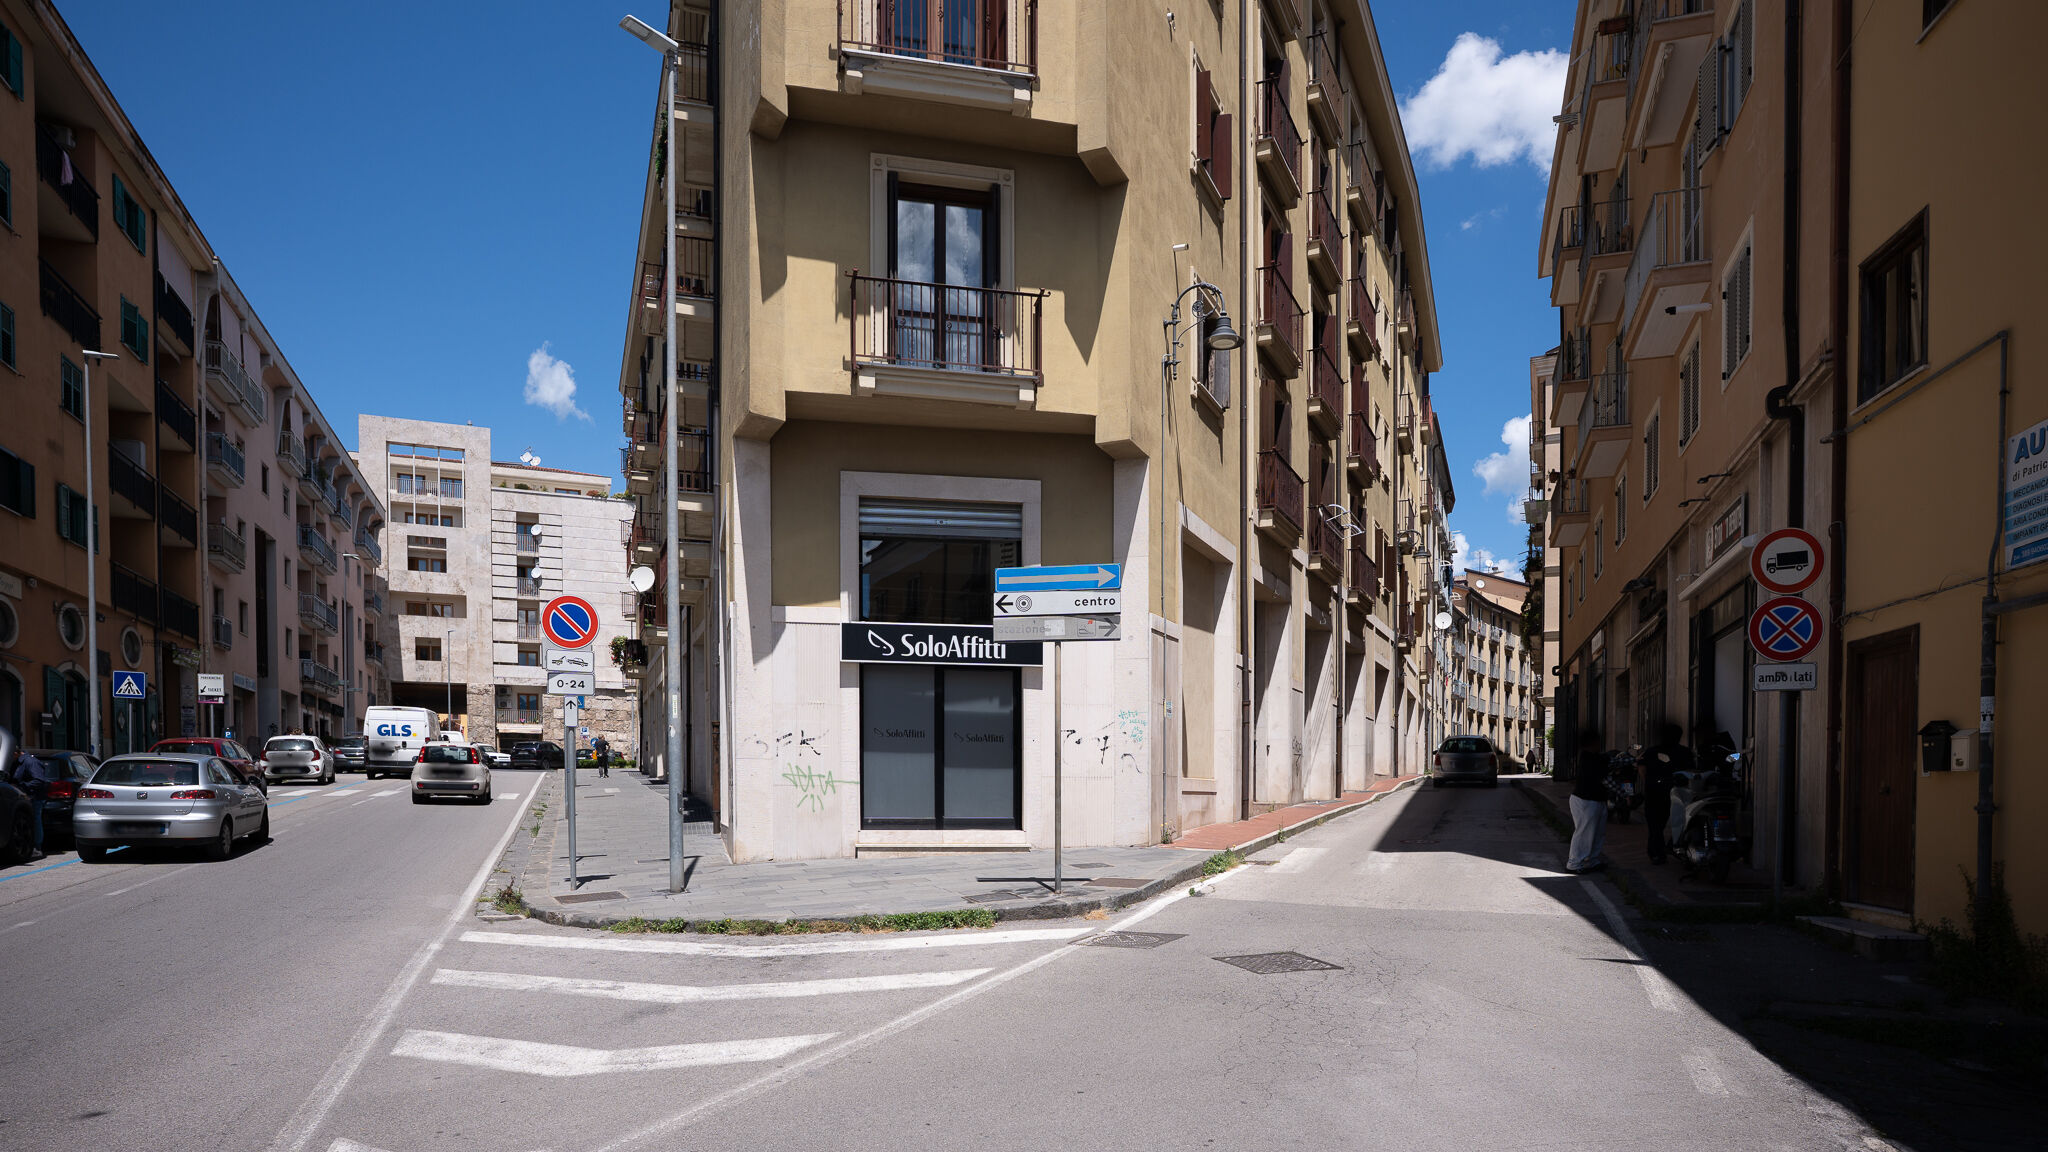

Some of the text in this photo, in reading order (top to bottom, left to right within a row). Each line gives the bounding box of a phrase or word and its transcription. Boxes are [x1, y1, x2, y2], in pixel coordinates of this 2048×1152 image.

[2014, 426, 2048, 465] AU
[1074, 596, 1116, 607] centro
[901, 633, 1006, 659] SoloAffitti
[1758, 671, 1788, 682] ambo
[1794, 671, 1812, 682] lati
[556, 679, 585, 689] 0-24
[886, 728, 925, 739] SoloAffitti
[966, 733, 1004, 744] SoloAffitti
